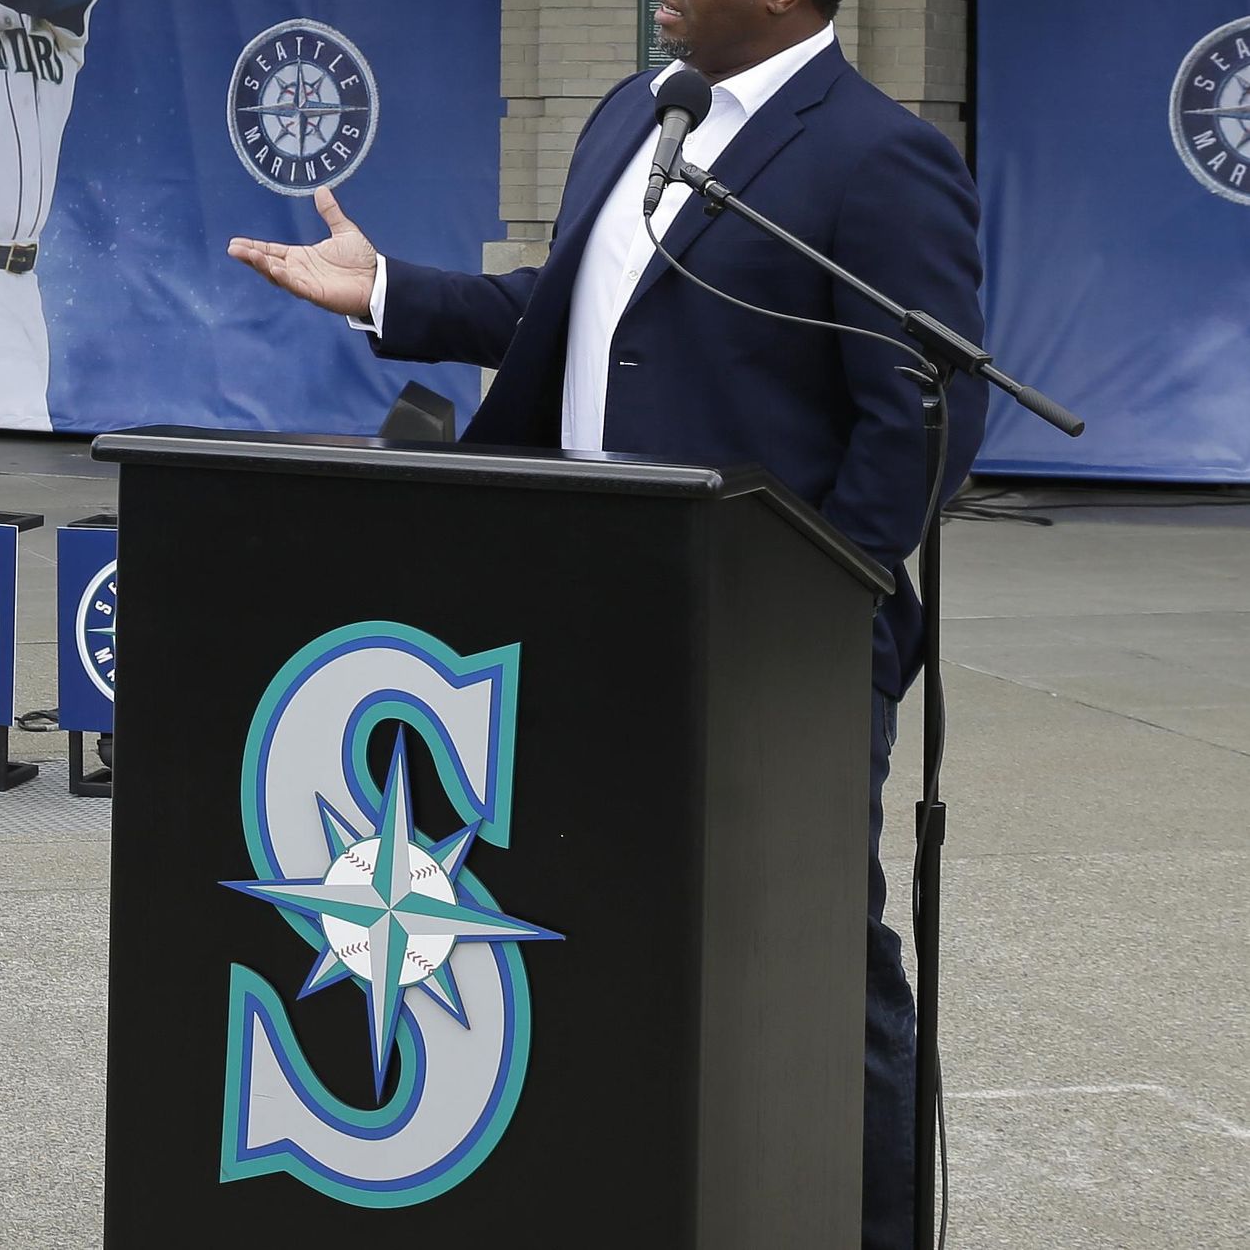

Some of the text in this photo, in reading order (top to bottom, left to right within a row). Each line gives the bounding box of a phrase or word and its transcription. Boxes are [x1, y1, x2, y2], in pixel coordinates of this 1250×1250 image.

[244, 36, 359, 91] SEATTLE
[244, 124, 360, 182] MARINERS
[1193, 130, 1248, 186] MAR
